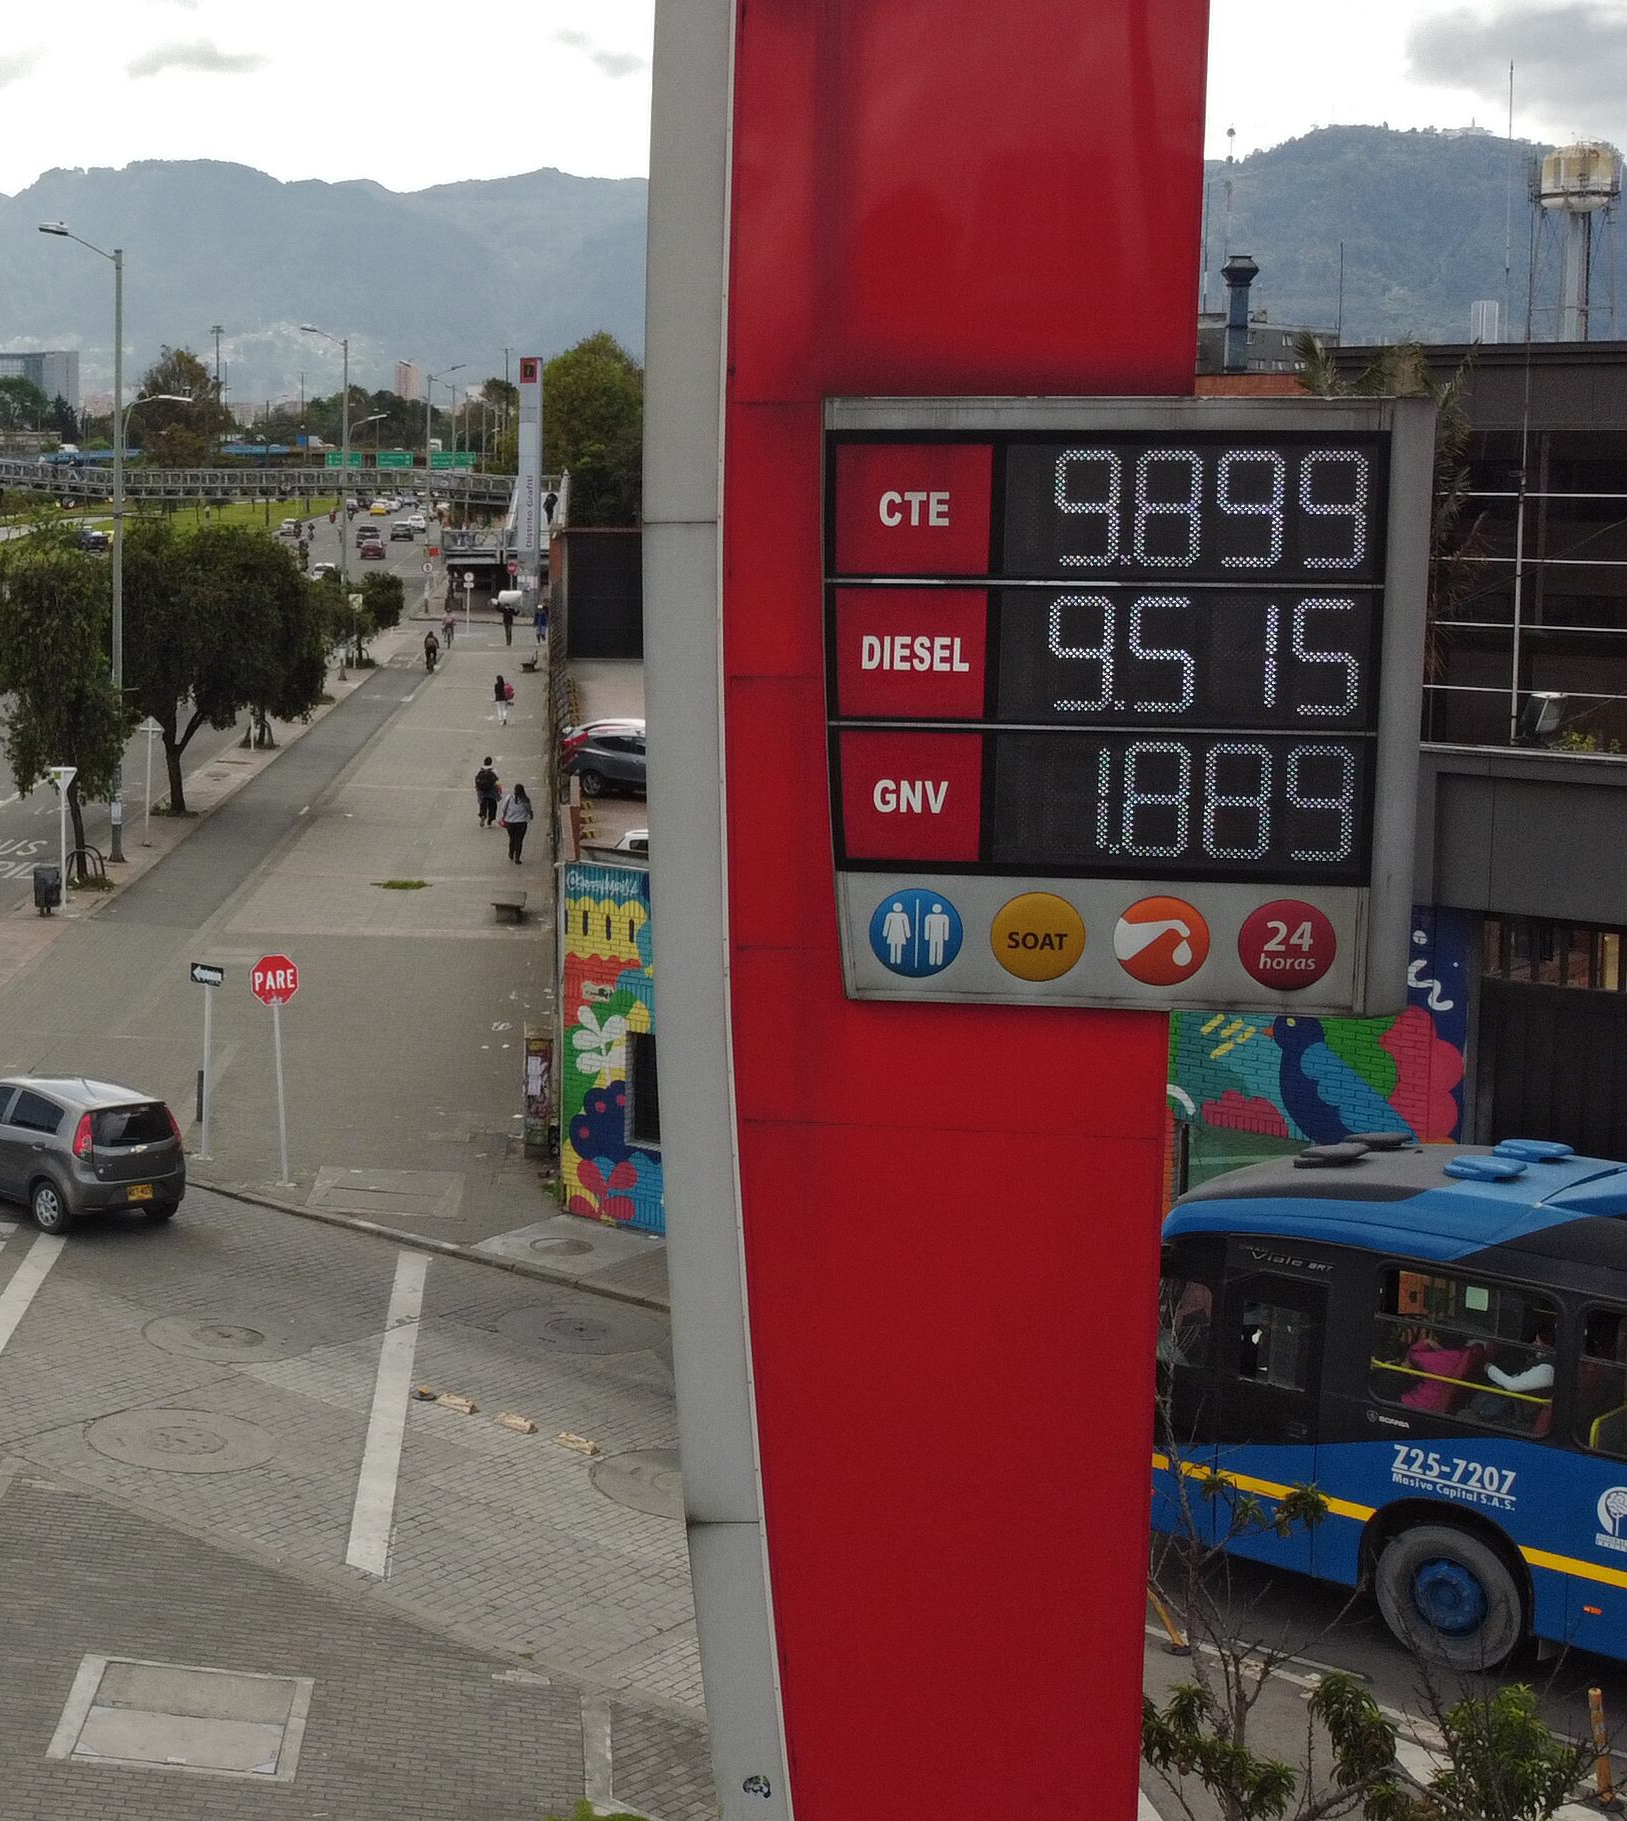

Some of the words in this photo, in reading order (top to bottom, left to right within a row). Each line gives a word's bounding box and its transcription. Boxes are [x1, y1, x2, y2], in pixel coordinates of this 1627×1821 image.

[879, 491, 950, 527] CTE
[1053, 449, 1369, 568] 9.899
[860, 635, 970, 673] DIESEL
[873, 778, 950, 815] GNV
[1095, 741, 1356, 862] 1.889
[1006, 930, 1069, 952] SOAT
[1262, 919, 1315, 953] 24
[254, 968, 296, 992] PARE
[1258, 953, 1317, 971] horas
[1392, 1443, 1517, 1494] Z25-7207
[1392, 1472, 1433, 1491] Masivo
[1435, 1483, 1478, 1503] Capital
[1480, 1494, 1516, 1512] S.A.S.
